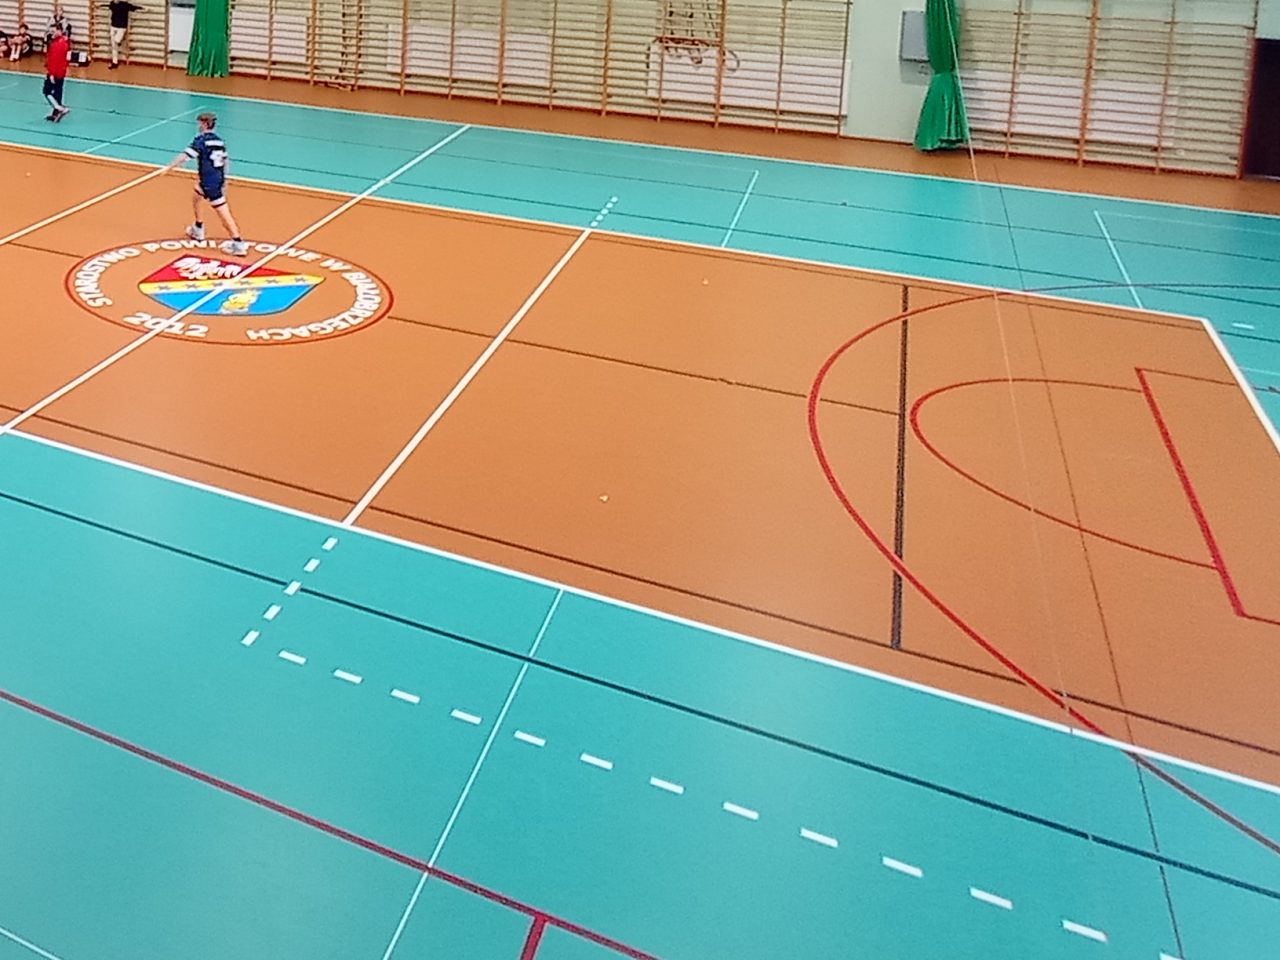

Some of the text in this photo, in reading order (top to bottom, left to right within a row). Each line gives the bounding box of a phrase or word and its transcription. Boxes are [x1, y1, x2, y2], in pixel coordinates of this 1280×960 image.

[74, 246, 141, 307] STAROSTWO
[320, 258, 352, 272] W
[122, 312, 209, 337] 2012
